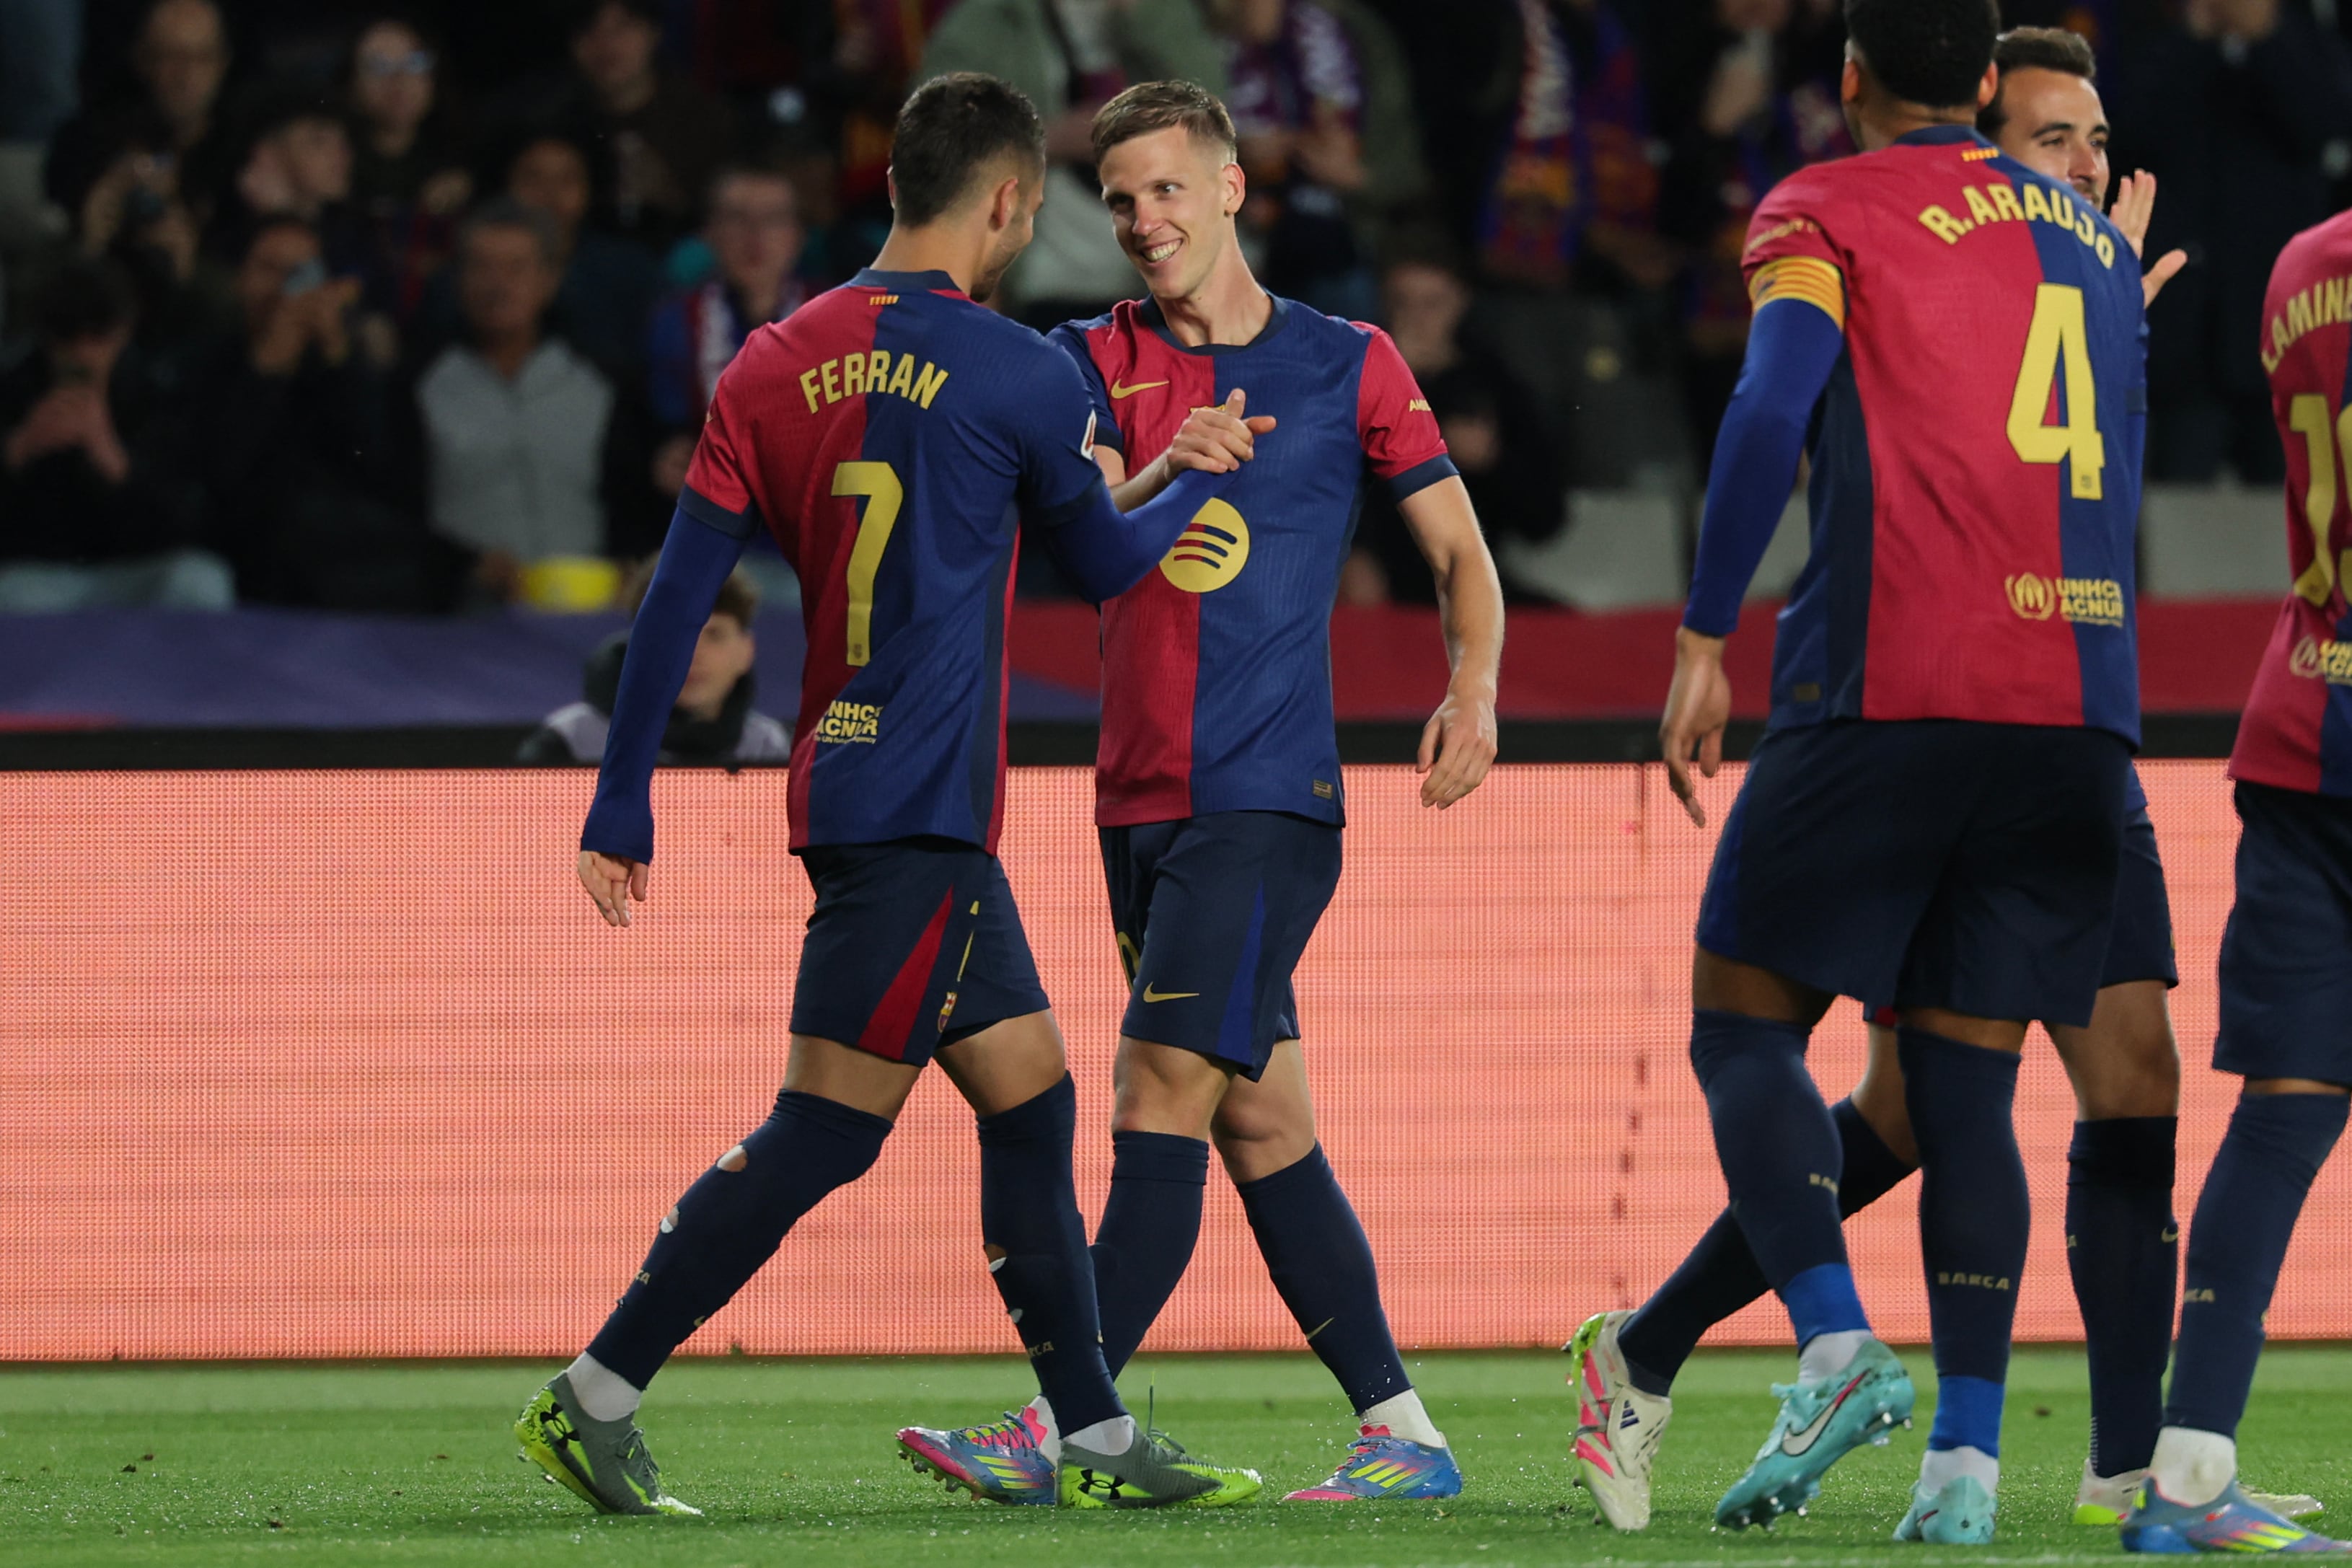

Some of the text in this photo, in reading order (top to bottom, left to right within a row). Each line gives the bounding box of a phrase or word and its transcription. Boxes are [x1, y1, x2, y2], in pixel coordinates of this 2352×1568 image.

[1918, 183, 2115, 270] R.ARAUJO
[799, 351, 949, 414] FERRAN
[2006, 282, 2105, 501] 4
[831, 462, 904, 666] 7
